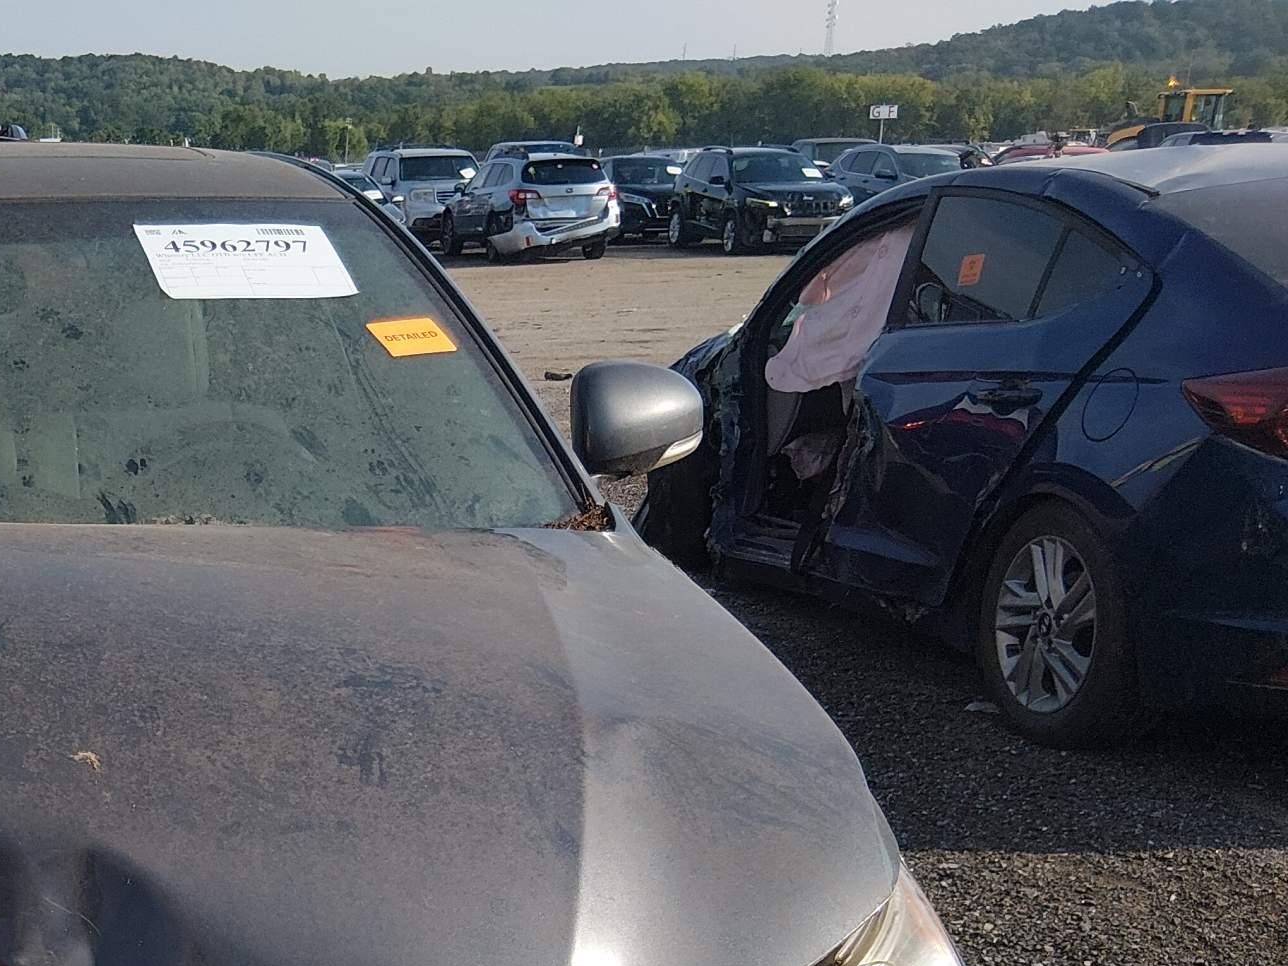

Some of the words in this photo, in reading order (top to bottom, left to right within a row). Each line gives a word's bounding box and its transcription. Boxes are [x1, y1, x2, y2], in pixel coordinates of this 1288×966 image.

[872, 105, 881, 118] G
[888, 105, 895, 118] F
[163, 239, 308, 253] 45962797
[384, 330, 438, 342] DETAILED
